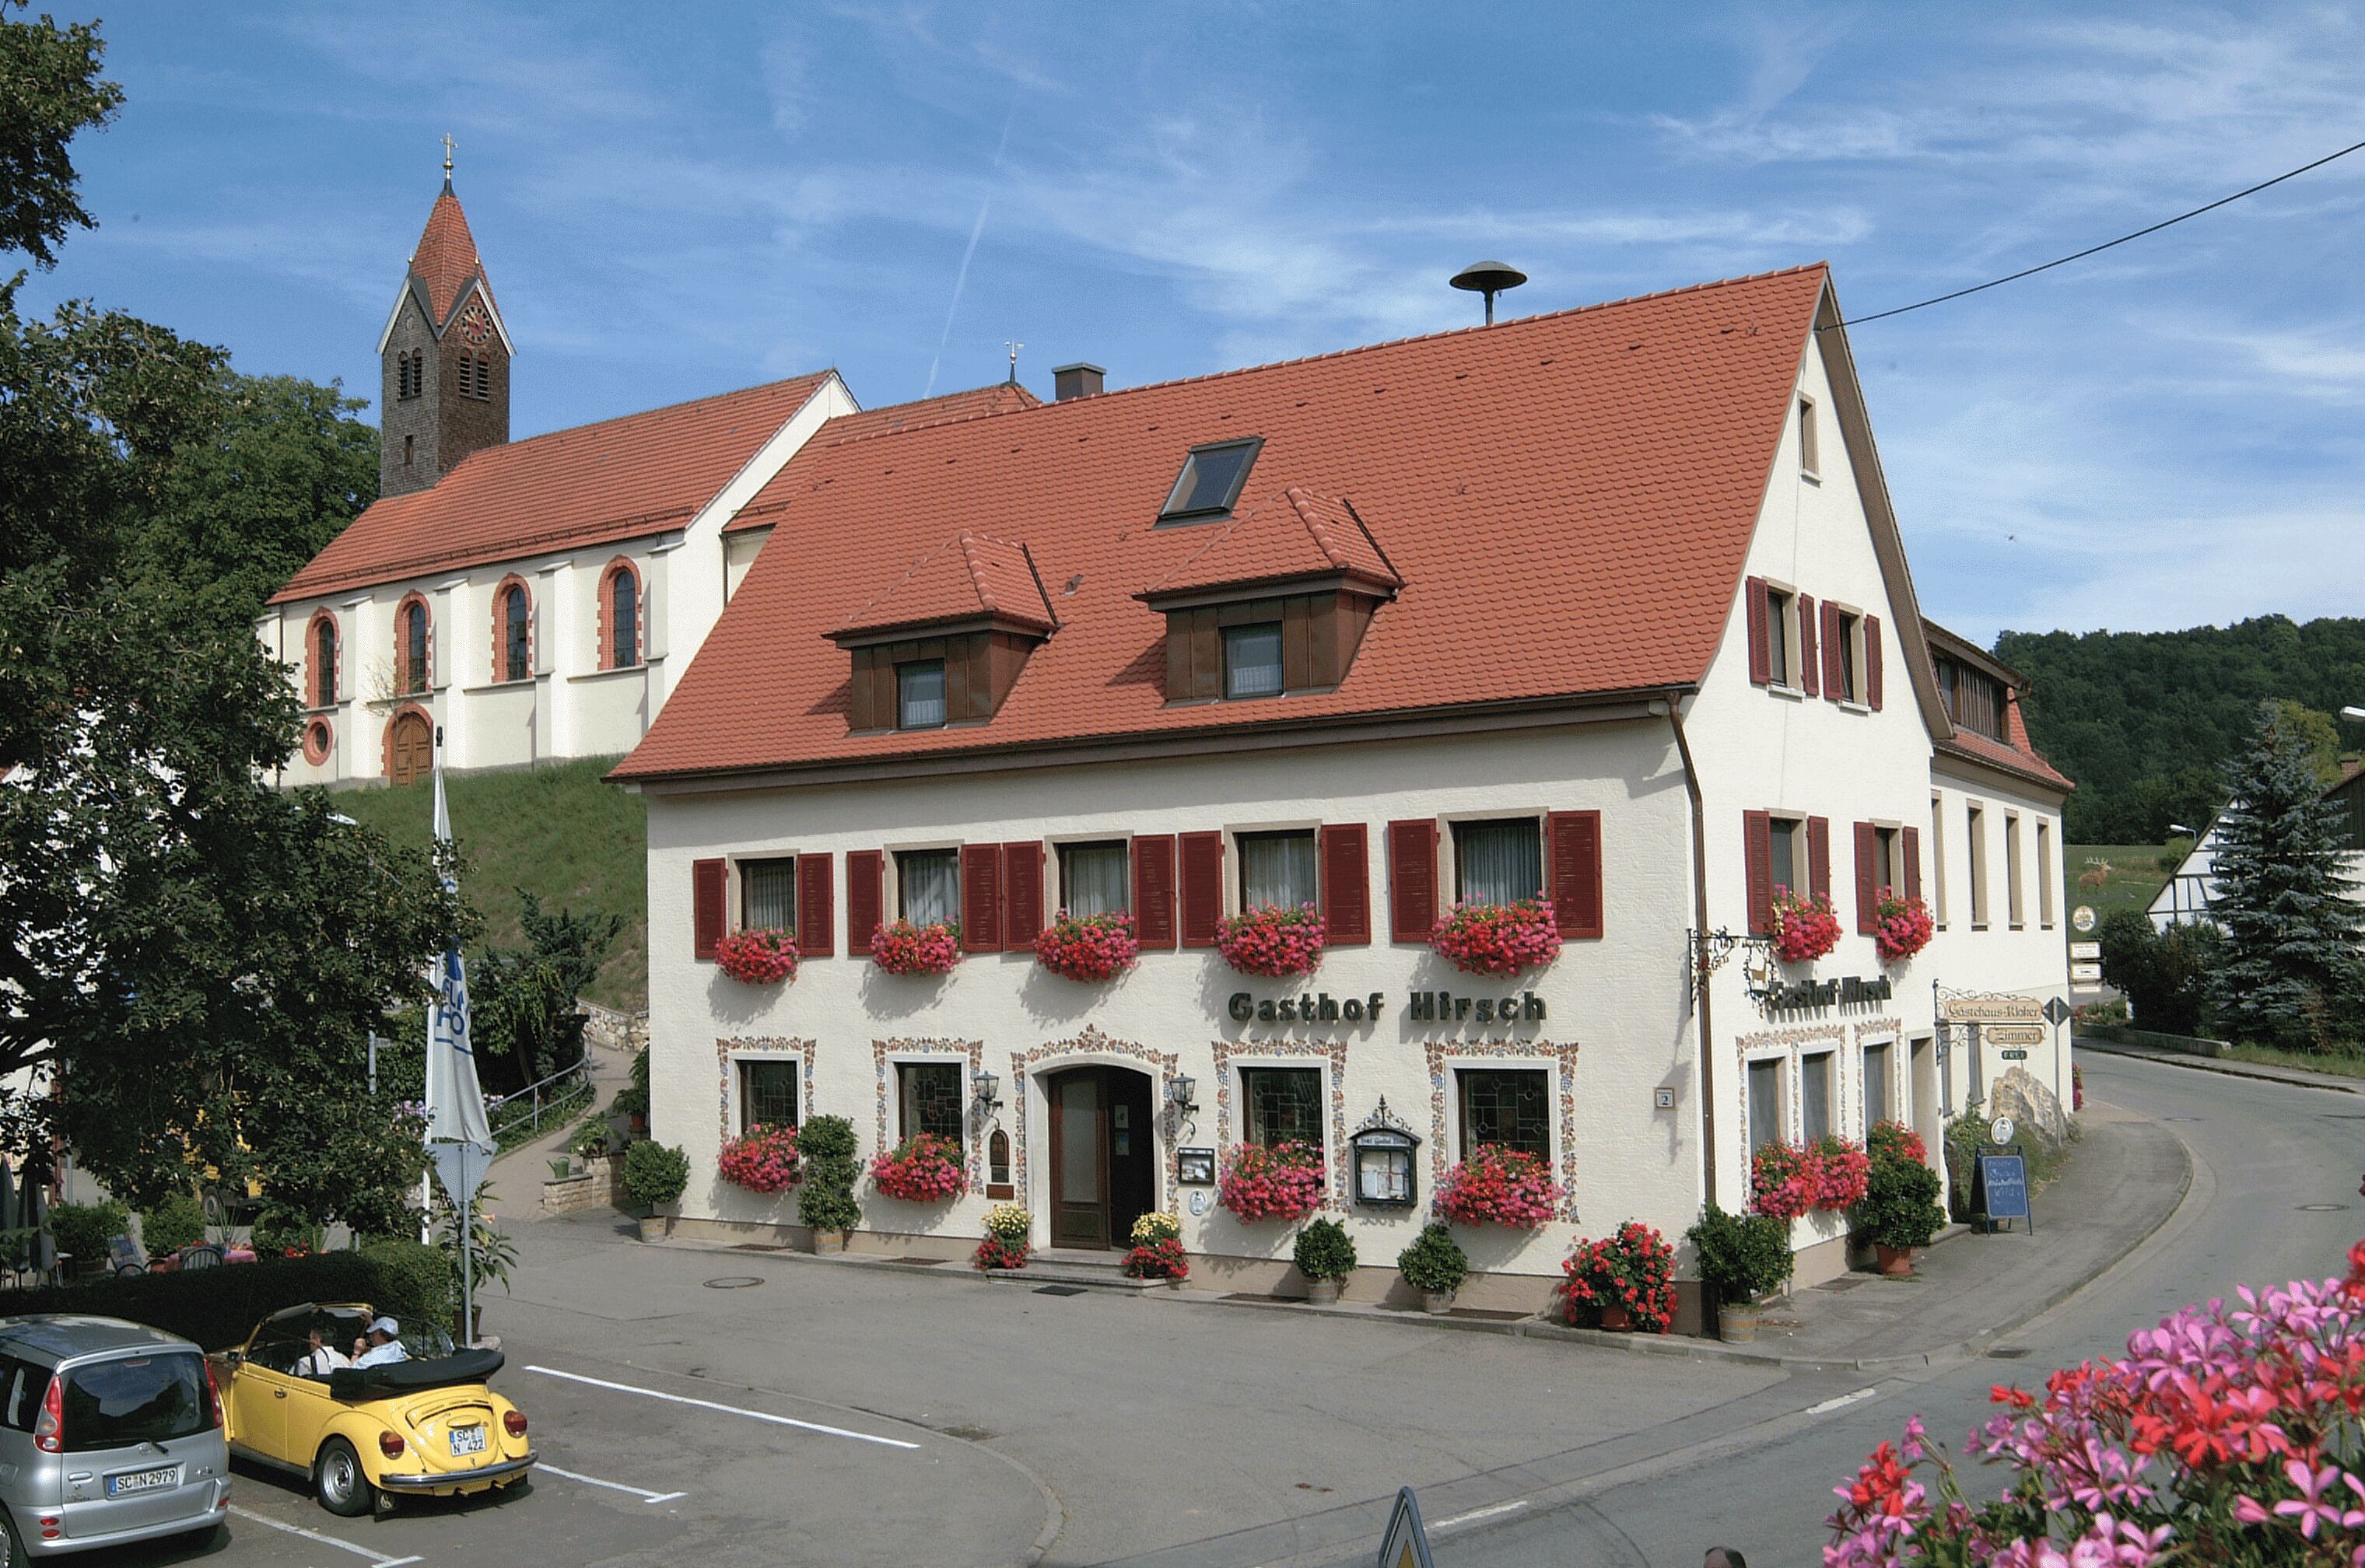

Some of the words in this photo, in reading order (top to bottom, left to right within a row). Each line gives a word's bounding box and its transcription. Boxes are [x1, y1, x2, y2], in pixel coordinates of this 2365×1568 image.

[1228, 992, 1384, 1021] Gasthof
[1410, 991, 1547, 1022] Hirsch
[1995, 1029, 2037, 1041] Zimmer
[1661, 1095, 1669, 1105] 2
[457, 1430, 469, 1442] SC
[453, 1443, 461, 1454] N
[467, 1439, 484, 1451] 422
